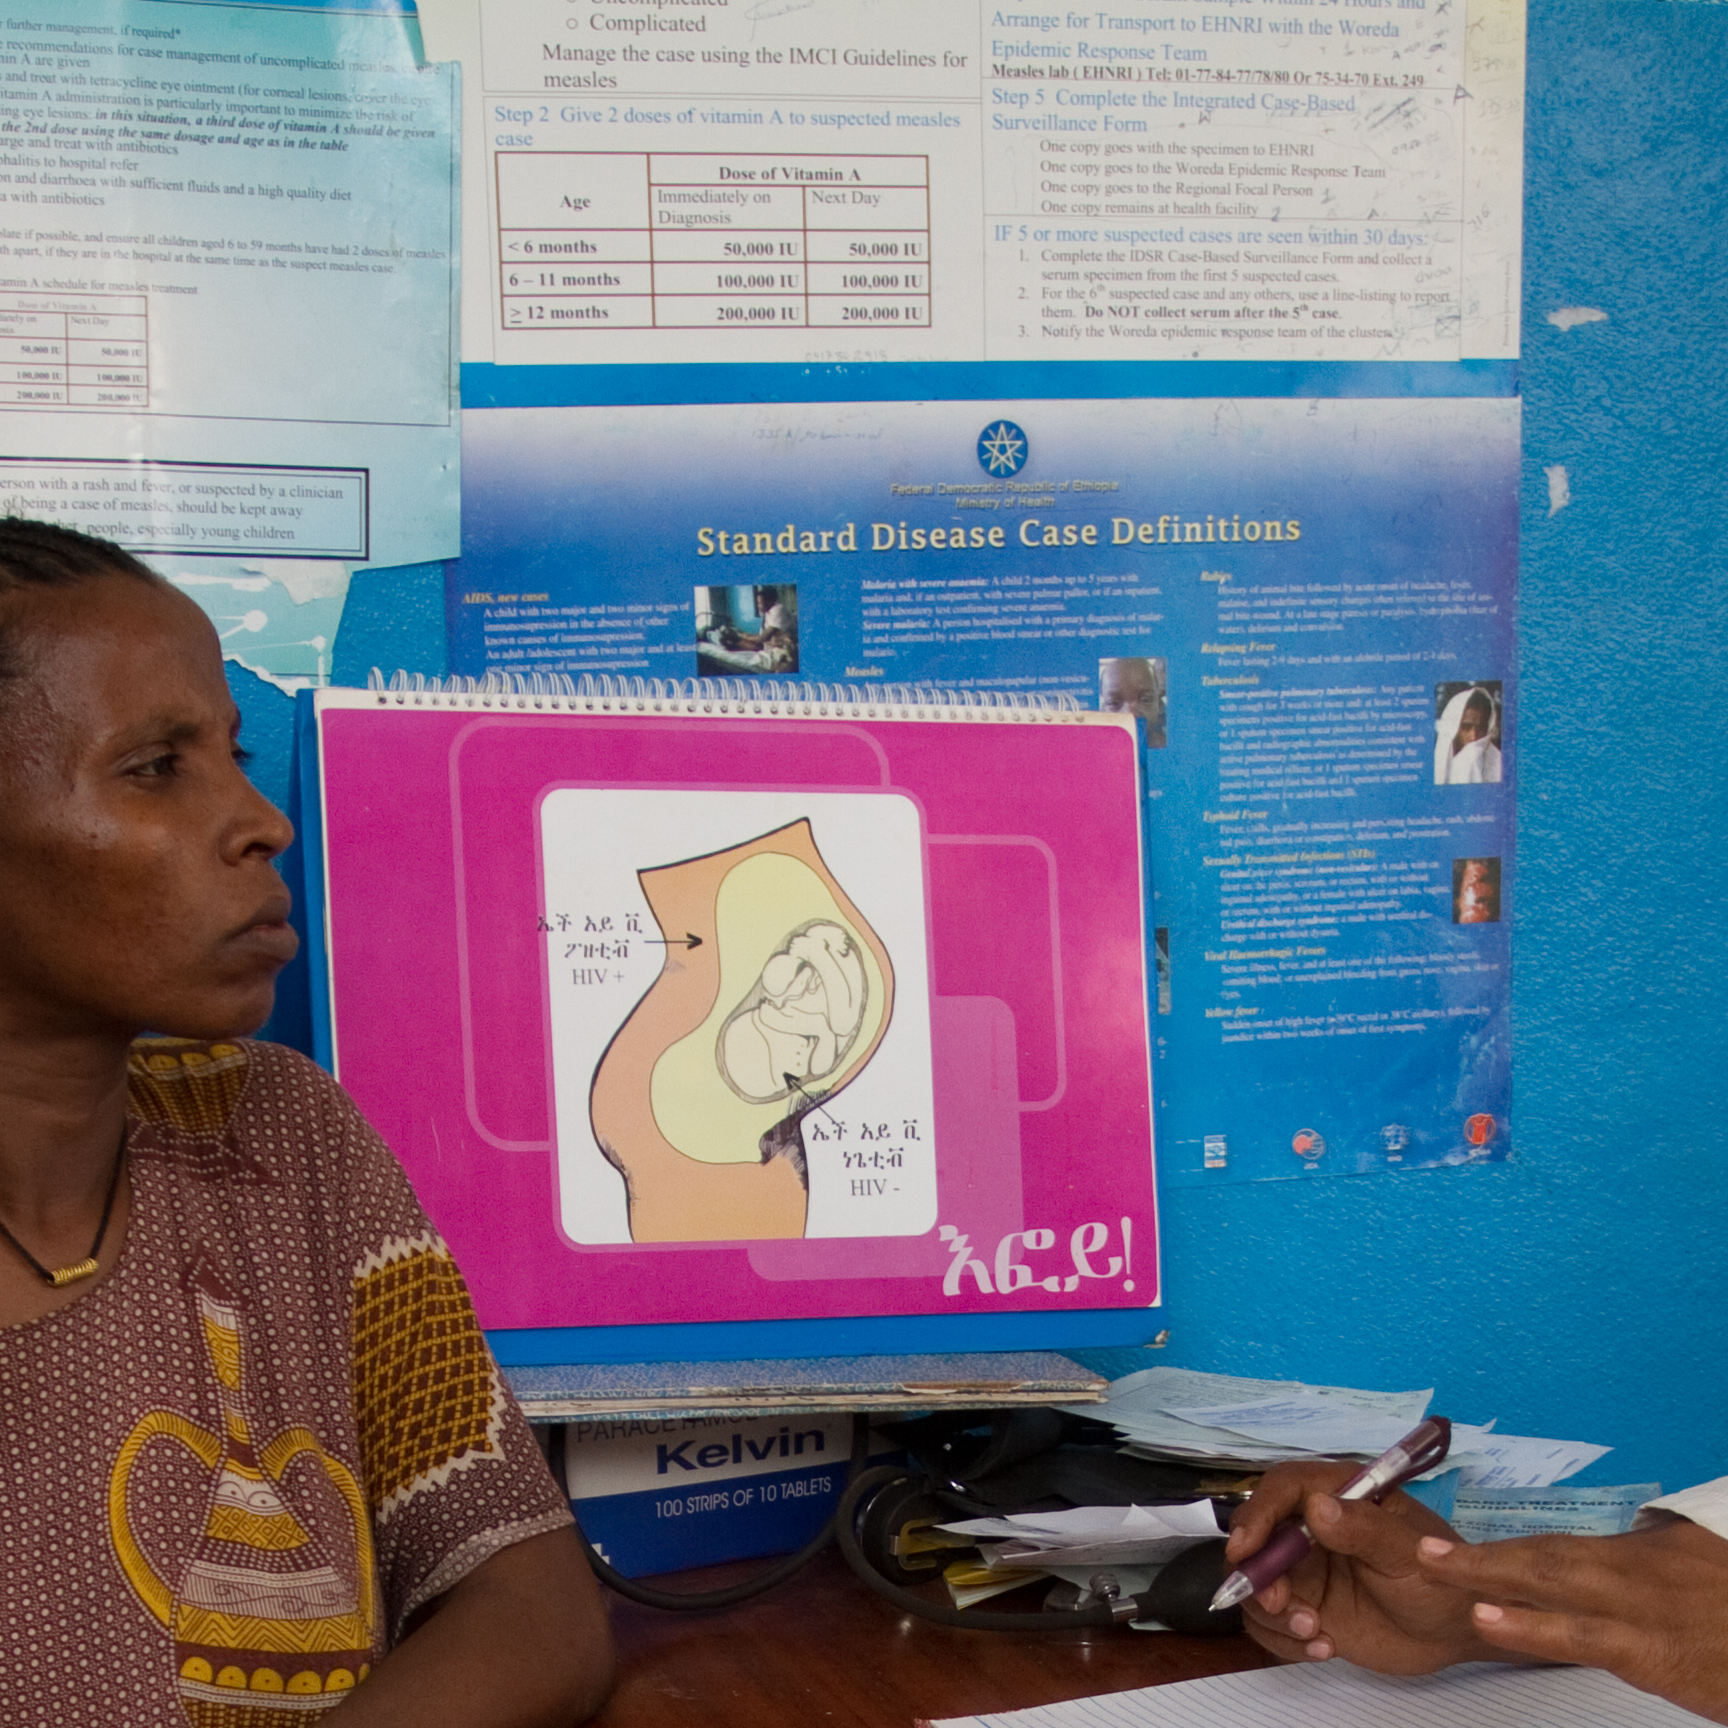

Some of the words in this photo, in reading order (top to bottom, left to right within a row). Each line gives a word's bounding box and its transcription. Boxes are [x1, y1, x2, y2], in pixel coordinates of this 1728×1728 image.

[589, 13, 707, 36] Complicated
[542, 43, 617, 66] Manage
[622, 44, 650, 62] the
[655, 50, 696, 62] case
[701, 45, 751, 68] using
[755, 46, 783, 64] the
[789, 47, 837, 65] IMCI
[842, 48, 937, 66] Guidelines
[943, 49, 969, 67] for
[543, 70, 618, 87] measles
[494, 105, 534, 126] Step
[538, 105, 549, 122] 2
[559, 106, 603, 123] Give
[607, 106, 618, 123] 2
[622, 106, 672, 123] doses
[675, 107, 697, 124] of
[699, 107, 764, 124] vitamin
[768, 108, 784, 125] A
[788, 110, 806, 125] to
[809, 109, 891, 130] suspected
[895, 109, 962, 127] measles
[494, 135, 534, 146] case
[718, 167, 759, 180] Dose
[757, 167, 780, 180] of
[778, 167, 847, 180] Vitamin
[845, 167, 862, 180] A
[559, 194, 592, 212] Age
[657, 188, 749, 207] Immediately
[752, 193, 772, 203] on
[811, 189, 851, 203] Next
[849, 189, 881, 208] Day
[657, 210, 733, 228] Diagnosis
[993, 223, 1013, 241] IF
[1017, 224, 1028, 241] 5
[1032, 229, 1052, 241] or
[1055, 229, 1099, 242] more
[1103, 225, 1185, 247] suspected
[1188, 231, 1233, 243] cases
[1236, 231, 1263, 244] are
[1266, 232, 1303, 244] seen
[1307, 227, 1359, 245] within
[1362, 228, 1387, 245] 30
[1385, 228, 1429, 251] days:
[523, 239, 534, 253] 6
[538, 239, 598, 253] months
[723, 242, 774, 258] 50,000
[779, 242, 798, 256] IU
[847, 243, 899, 258] 50,000
[903, 243, 923, 256] IU
[508, 271, 519, 285] 6
[539, 271, 555, 286] 11
[561, 271, 622, 286] months
[715, 274, 775, 290] 100,000
[779, 274, 800, 288] IU
[840, 274, 899, 290] 100,000
[903, 274, 924, 288] IU
[527, 305, 545, 319] 12
[550, 304, 609, 319] months
[715, 306, 776, 322] 200,000
[780, 307, 801, 320] IU
[840, 306, 899, 322] 200,000
[904, 306, 924, 319] IU
[38, 476, 68, 490] with
[71, 481, 80, 491] a
[82, 477, 111, 492] rash
[112, 478, 138, 492] and
[140, 479, 176, 496] fever,
[177, 484, 193, 494] or
[194, 481, 257, 499] suspected
[258, 483, 275, 500] by
[277, 487, 287, 497] a
[288, 483, 344, 498] clinician
[696, 521, 858, 554] Standard
[870, 518, 1006, 551] Disease
[1018, 517, 1099, 548] Case
[1110, 513, 1302, 546] Definitions
[572, 969, 608, 985] HIV
[851, 1179, 887, 1196] HIV
[656, 1427, 825, 1474] Kelvin
[656, 1500, 683, 1518] 100
[687, 1492, 728, 1514] STRIPS
[732, 1488, 754, 1507] OF
[760, 1484, 776, 1502] 10
[781, 1476, 831, 1498] TABLETS
